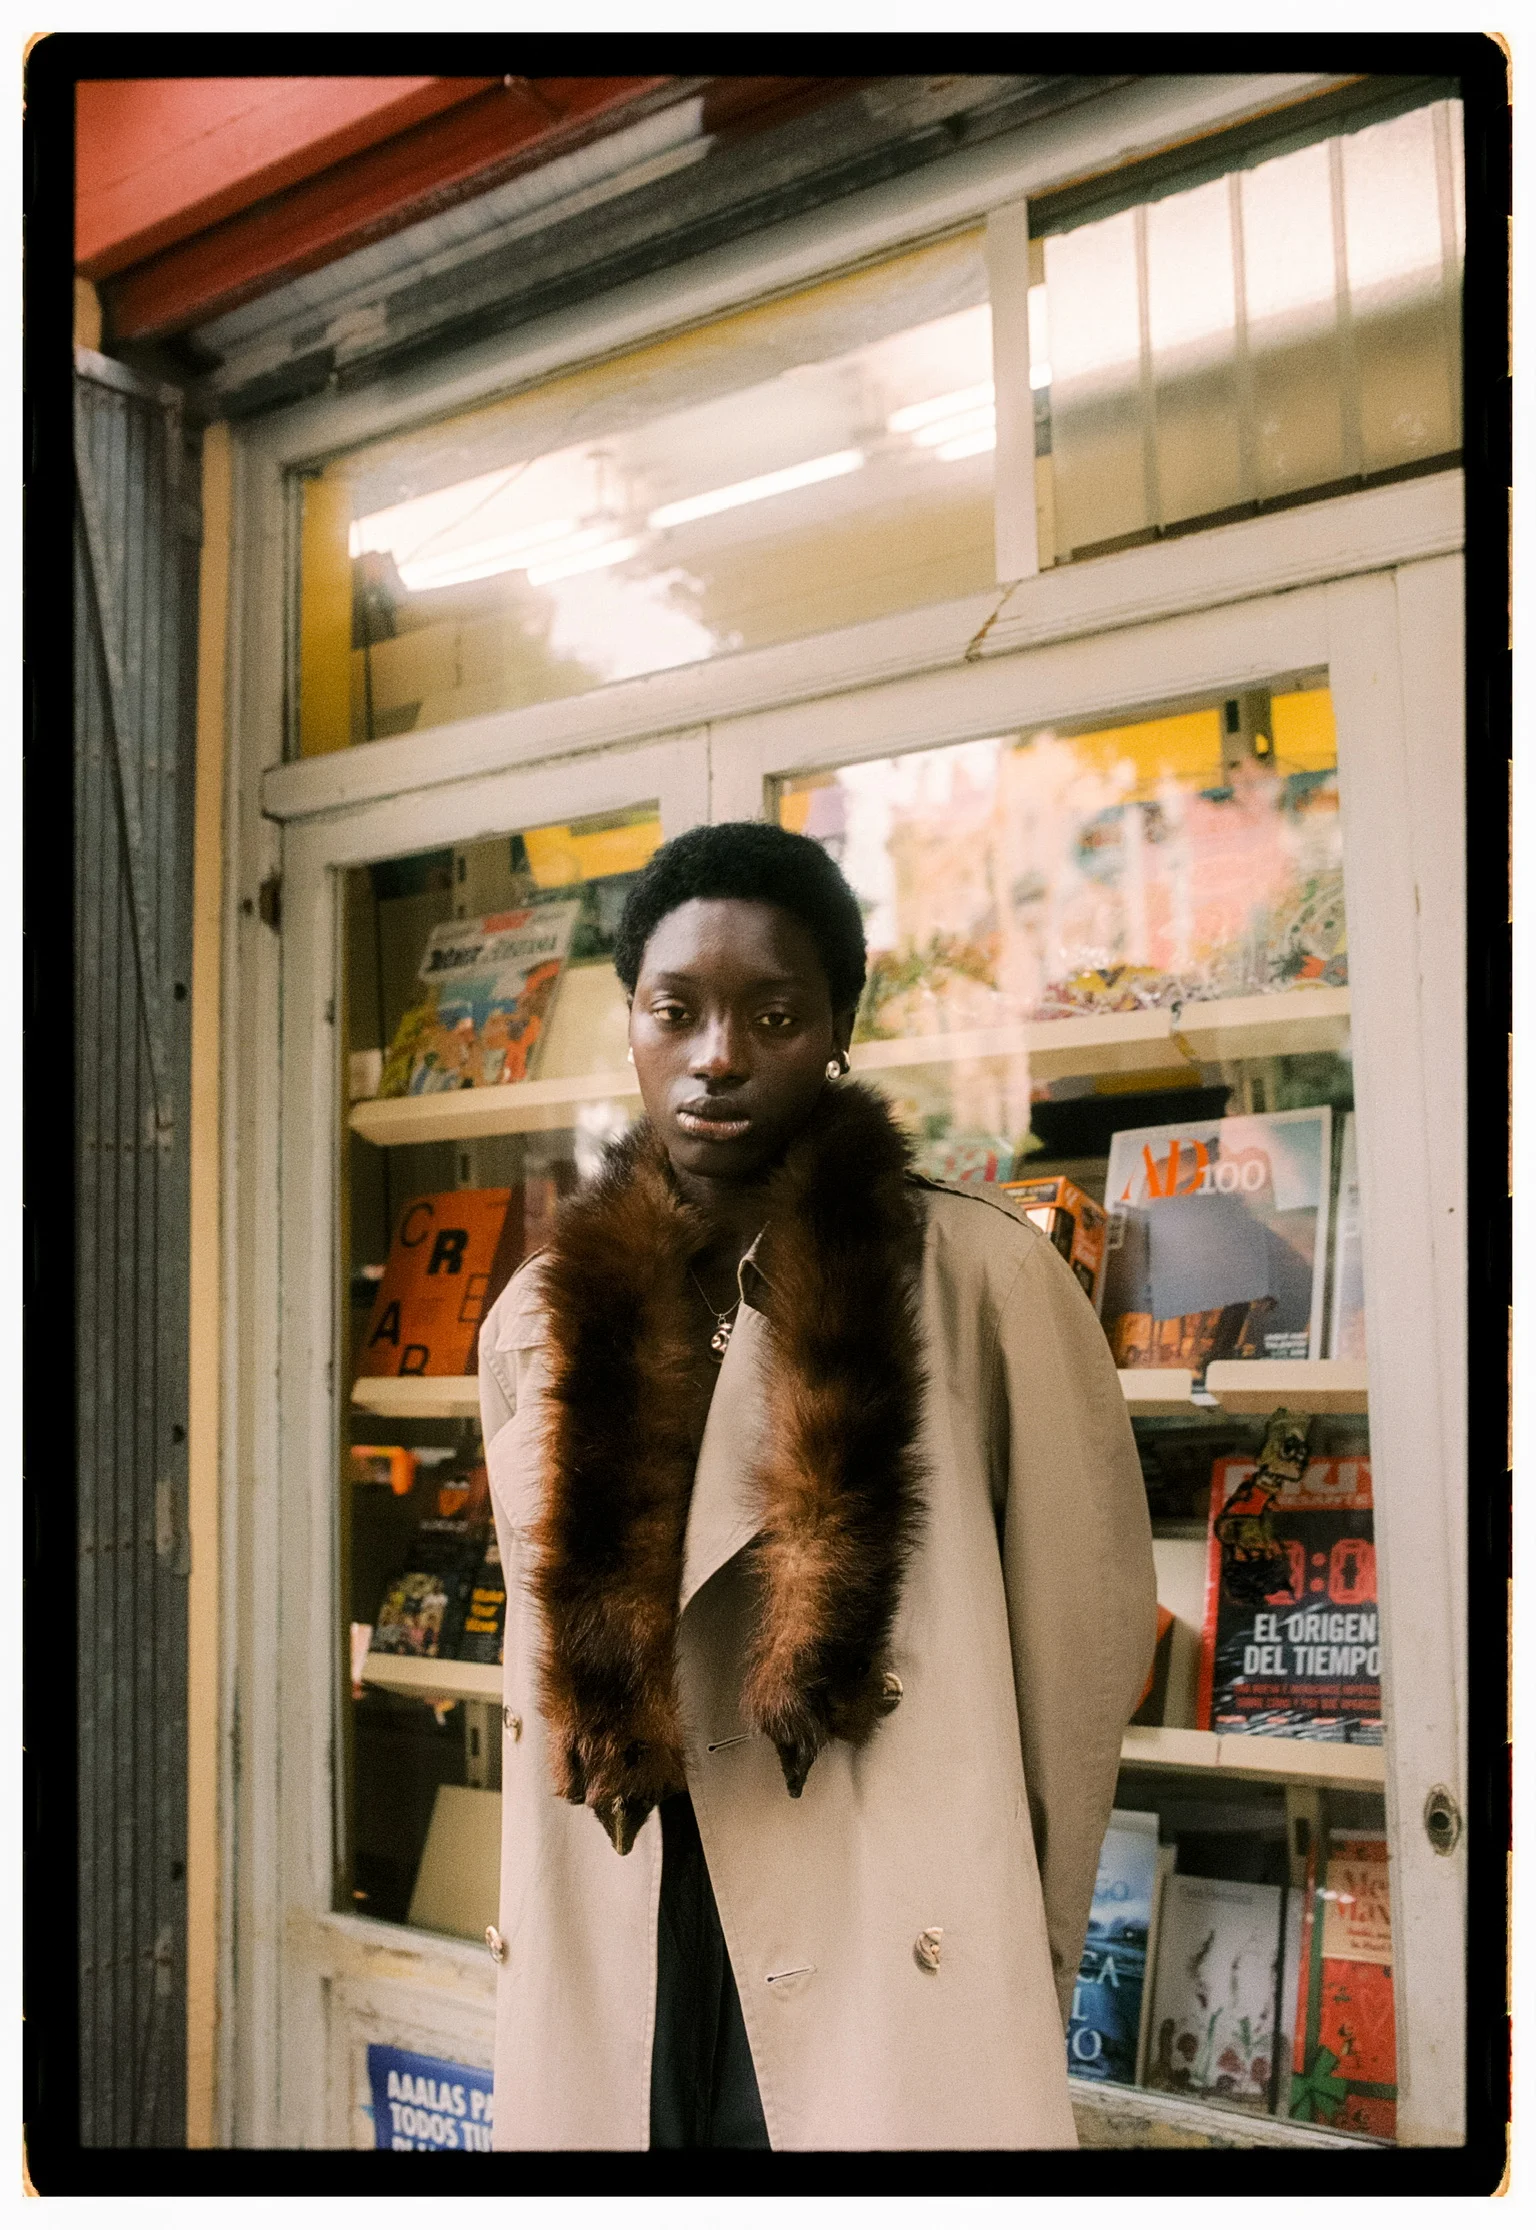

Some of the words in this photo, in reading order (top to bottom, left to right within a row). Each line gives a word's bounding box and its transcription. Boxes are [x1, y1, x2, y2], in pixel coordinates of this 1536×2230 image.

[1121, 1138, 1209, 1200] AD
[1197, 1160, 1267, 1195] 100
[1253, 1613, 1282, 1643] EL
[1287, 1613, 1377, 1643] ORIGEN
[1243, 1646, 1287, 1676] DEL
[1293, 1646, 1381, 1676] TIEMPO
[387, 2070, 467, 2117] AAALAS
[389, 2101, 459, 2149] TODOS
[460, 2119, 494, 2152] TU
